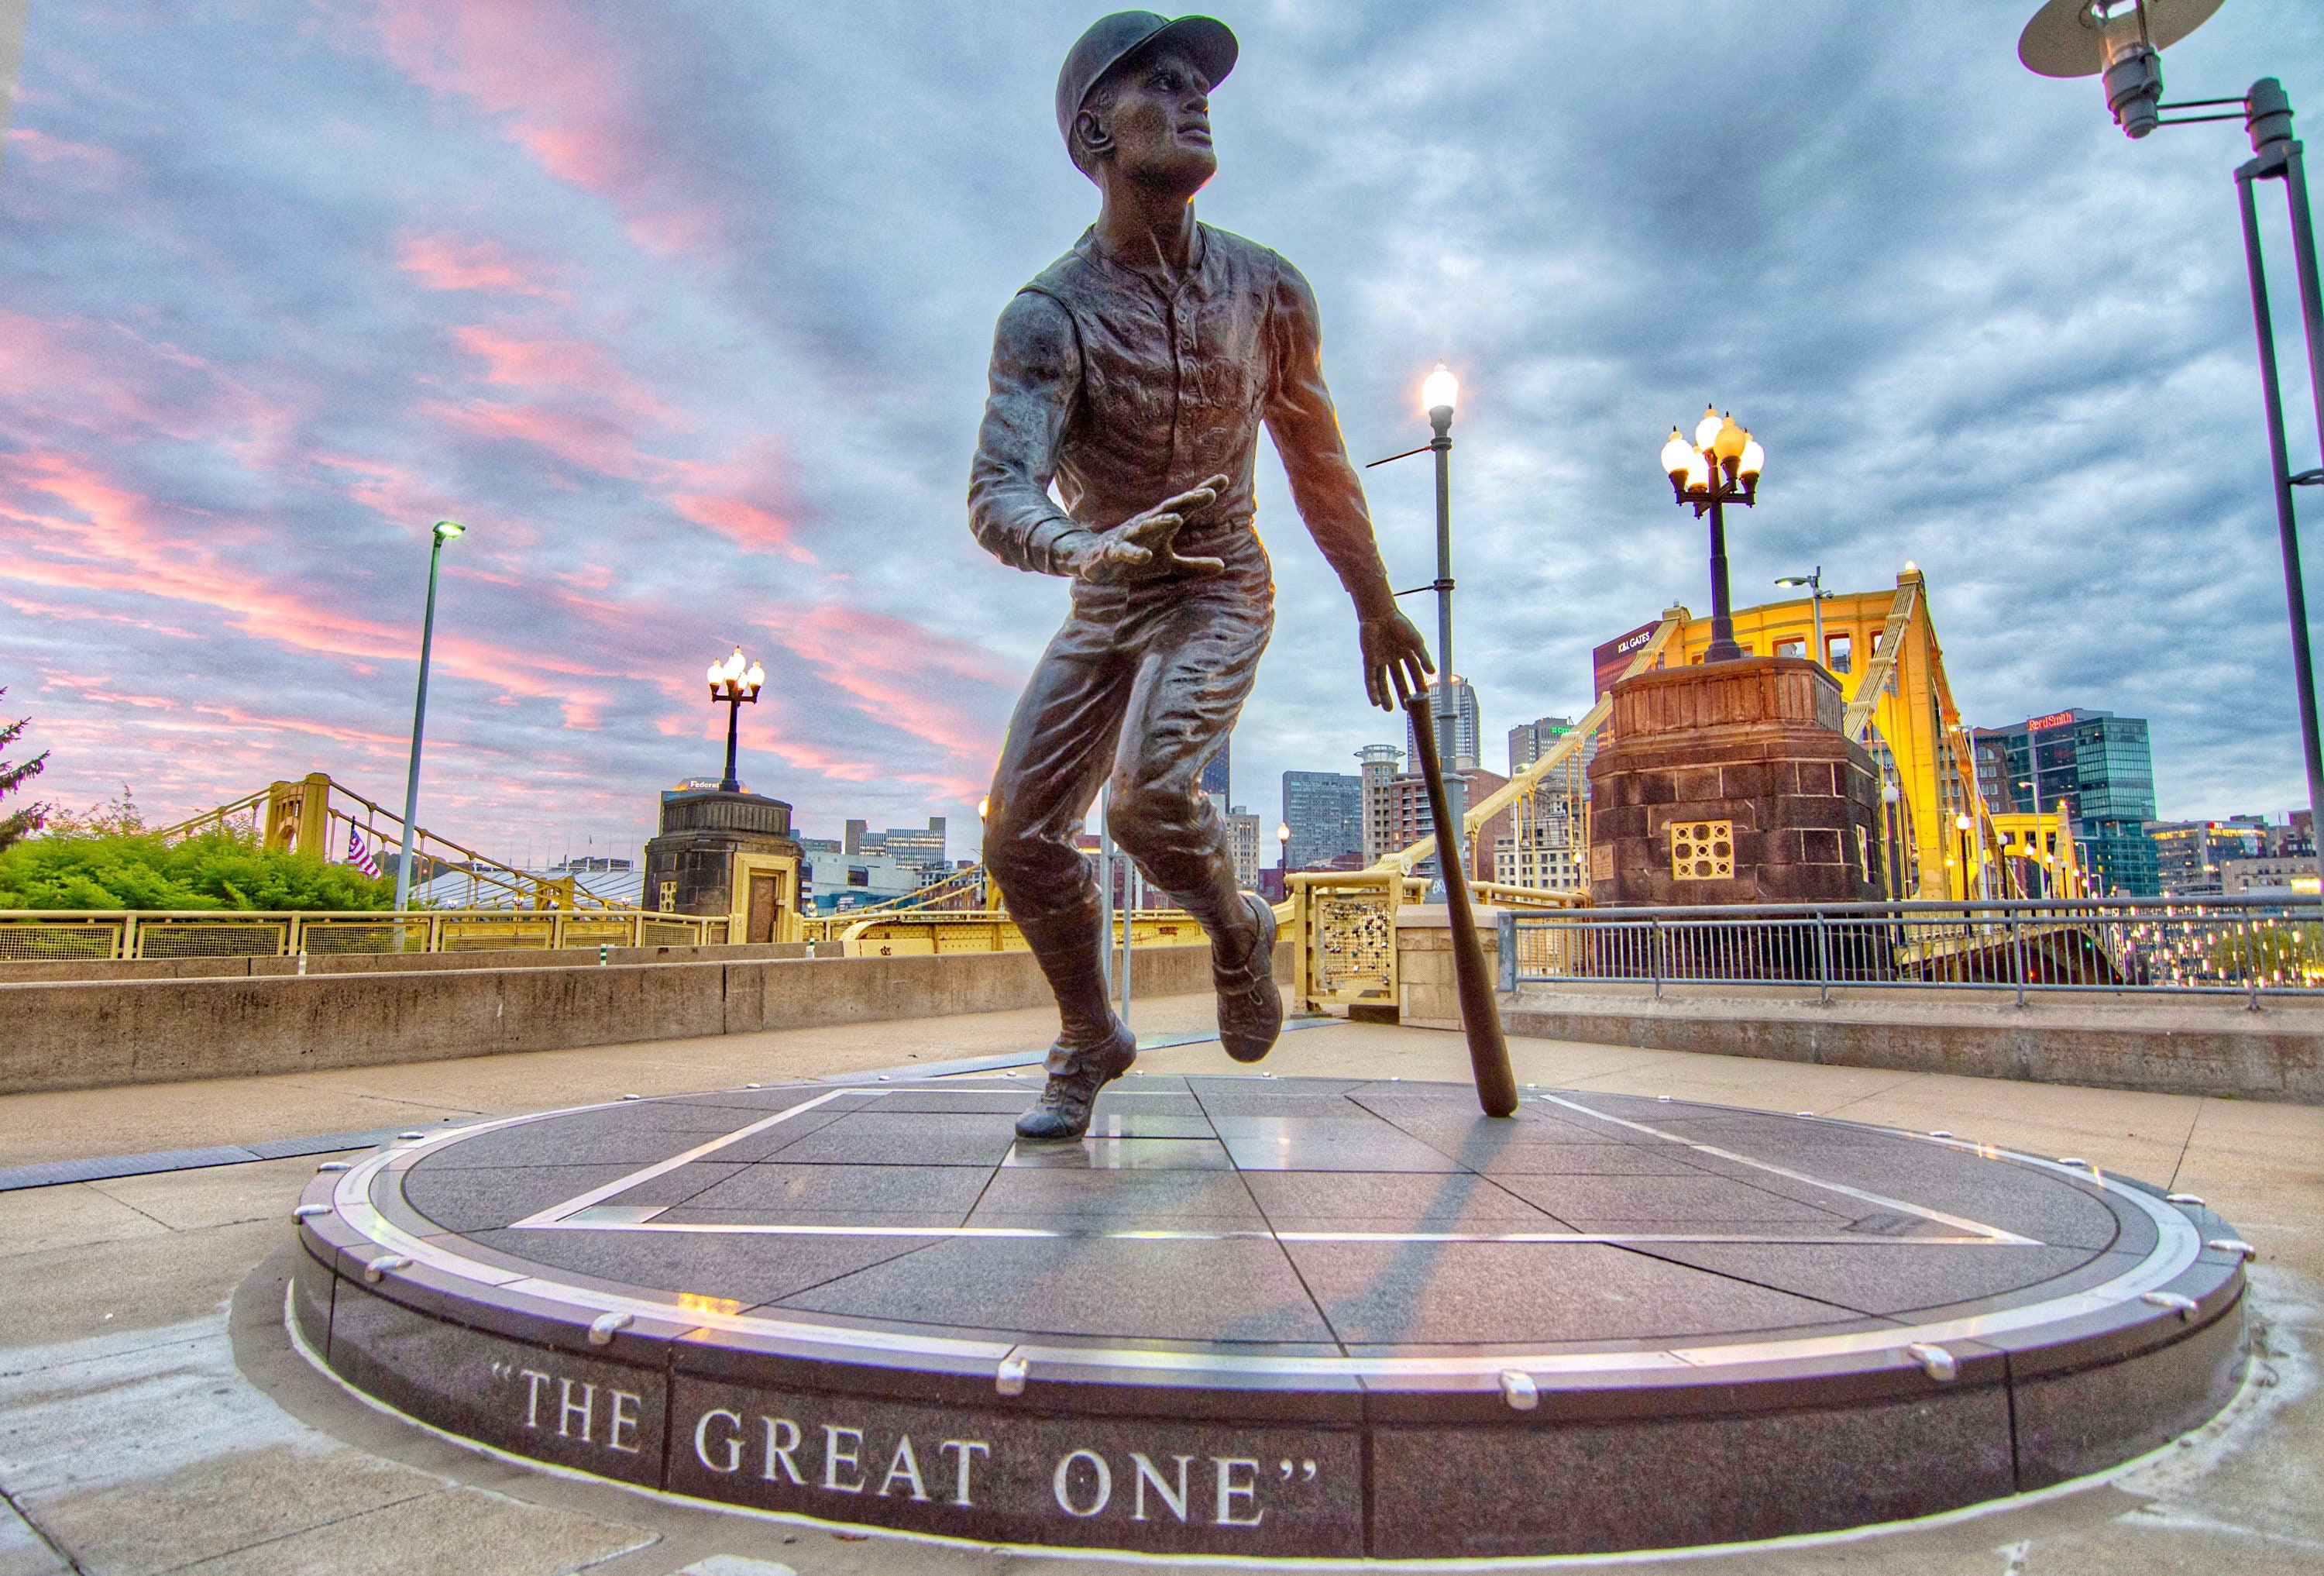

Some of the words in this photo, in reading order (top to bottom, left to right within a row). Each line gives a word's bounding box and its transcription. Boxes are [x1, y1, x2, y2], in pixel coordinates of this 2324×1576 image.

[1618, 641, 1630, 653] K&L
[1630, 631, 1650, 648] GATES
[695, 1408, 991, 1507] GREAT
